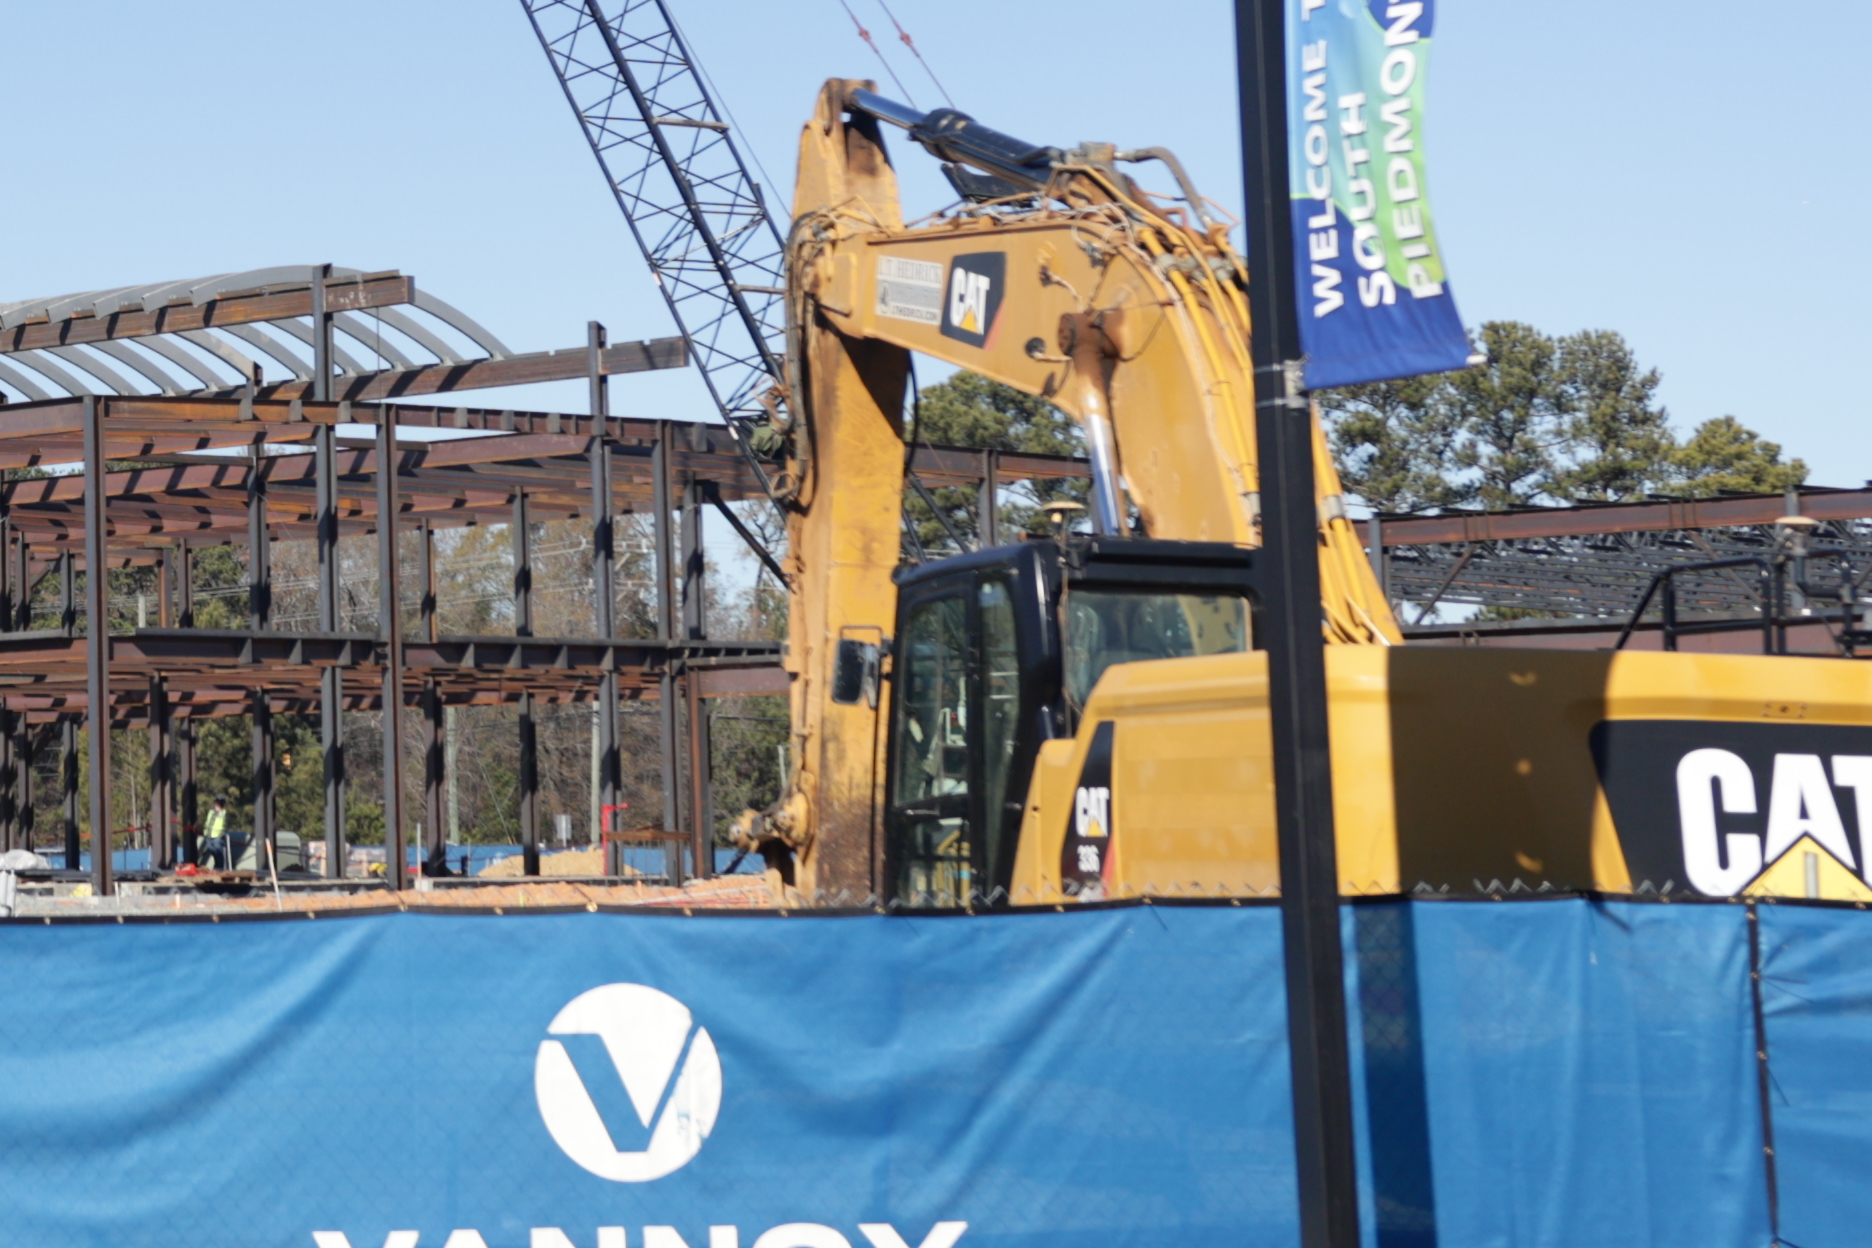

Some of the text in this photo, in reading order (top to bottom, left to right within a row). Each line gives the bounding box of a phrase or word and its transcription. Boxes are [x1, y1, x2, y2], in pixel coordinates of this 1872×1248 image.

[1302, 39, 1344, 318] WELCOME
[1338, 91, 1397, 308] SOUTH
[950, 267, 990, 335] CAT
[1076, 786, 1110, 838] CAT
